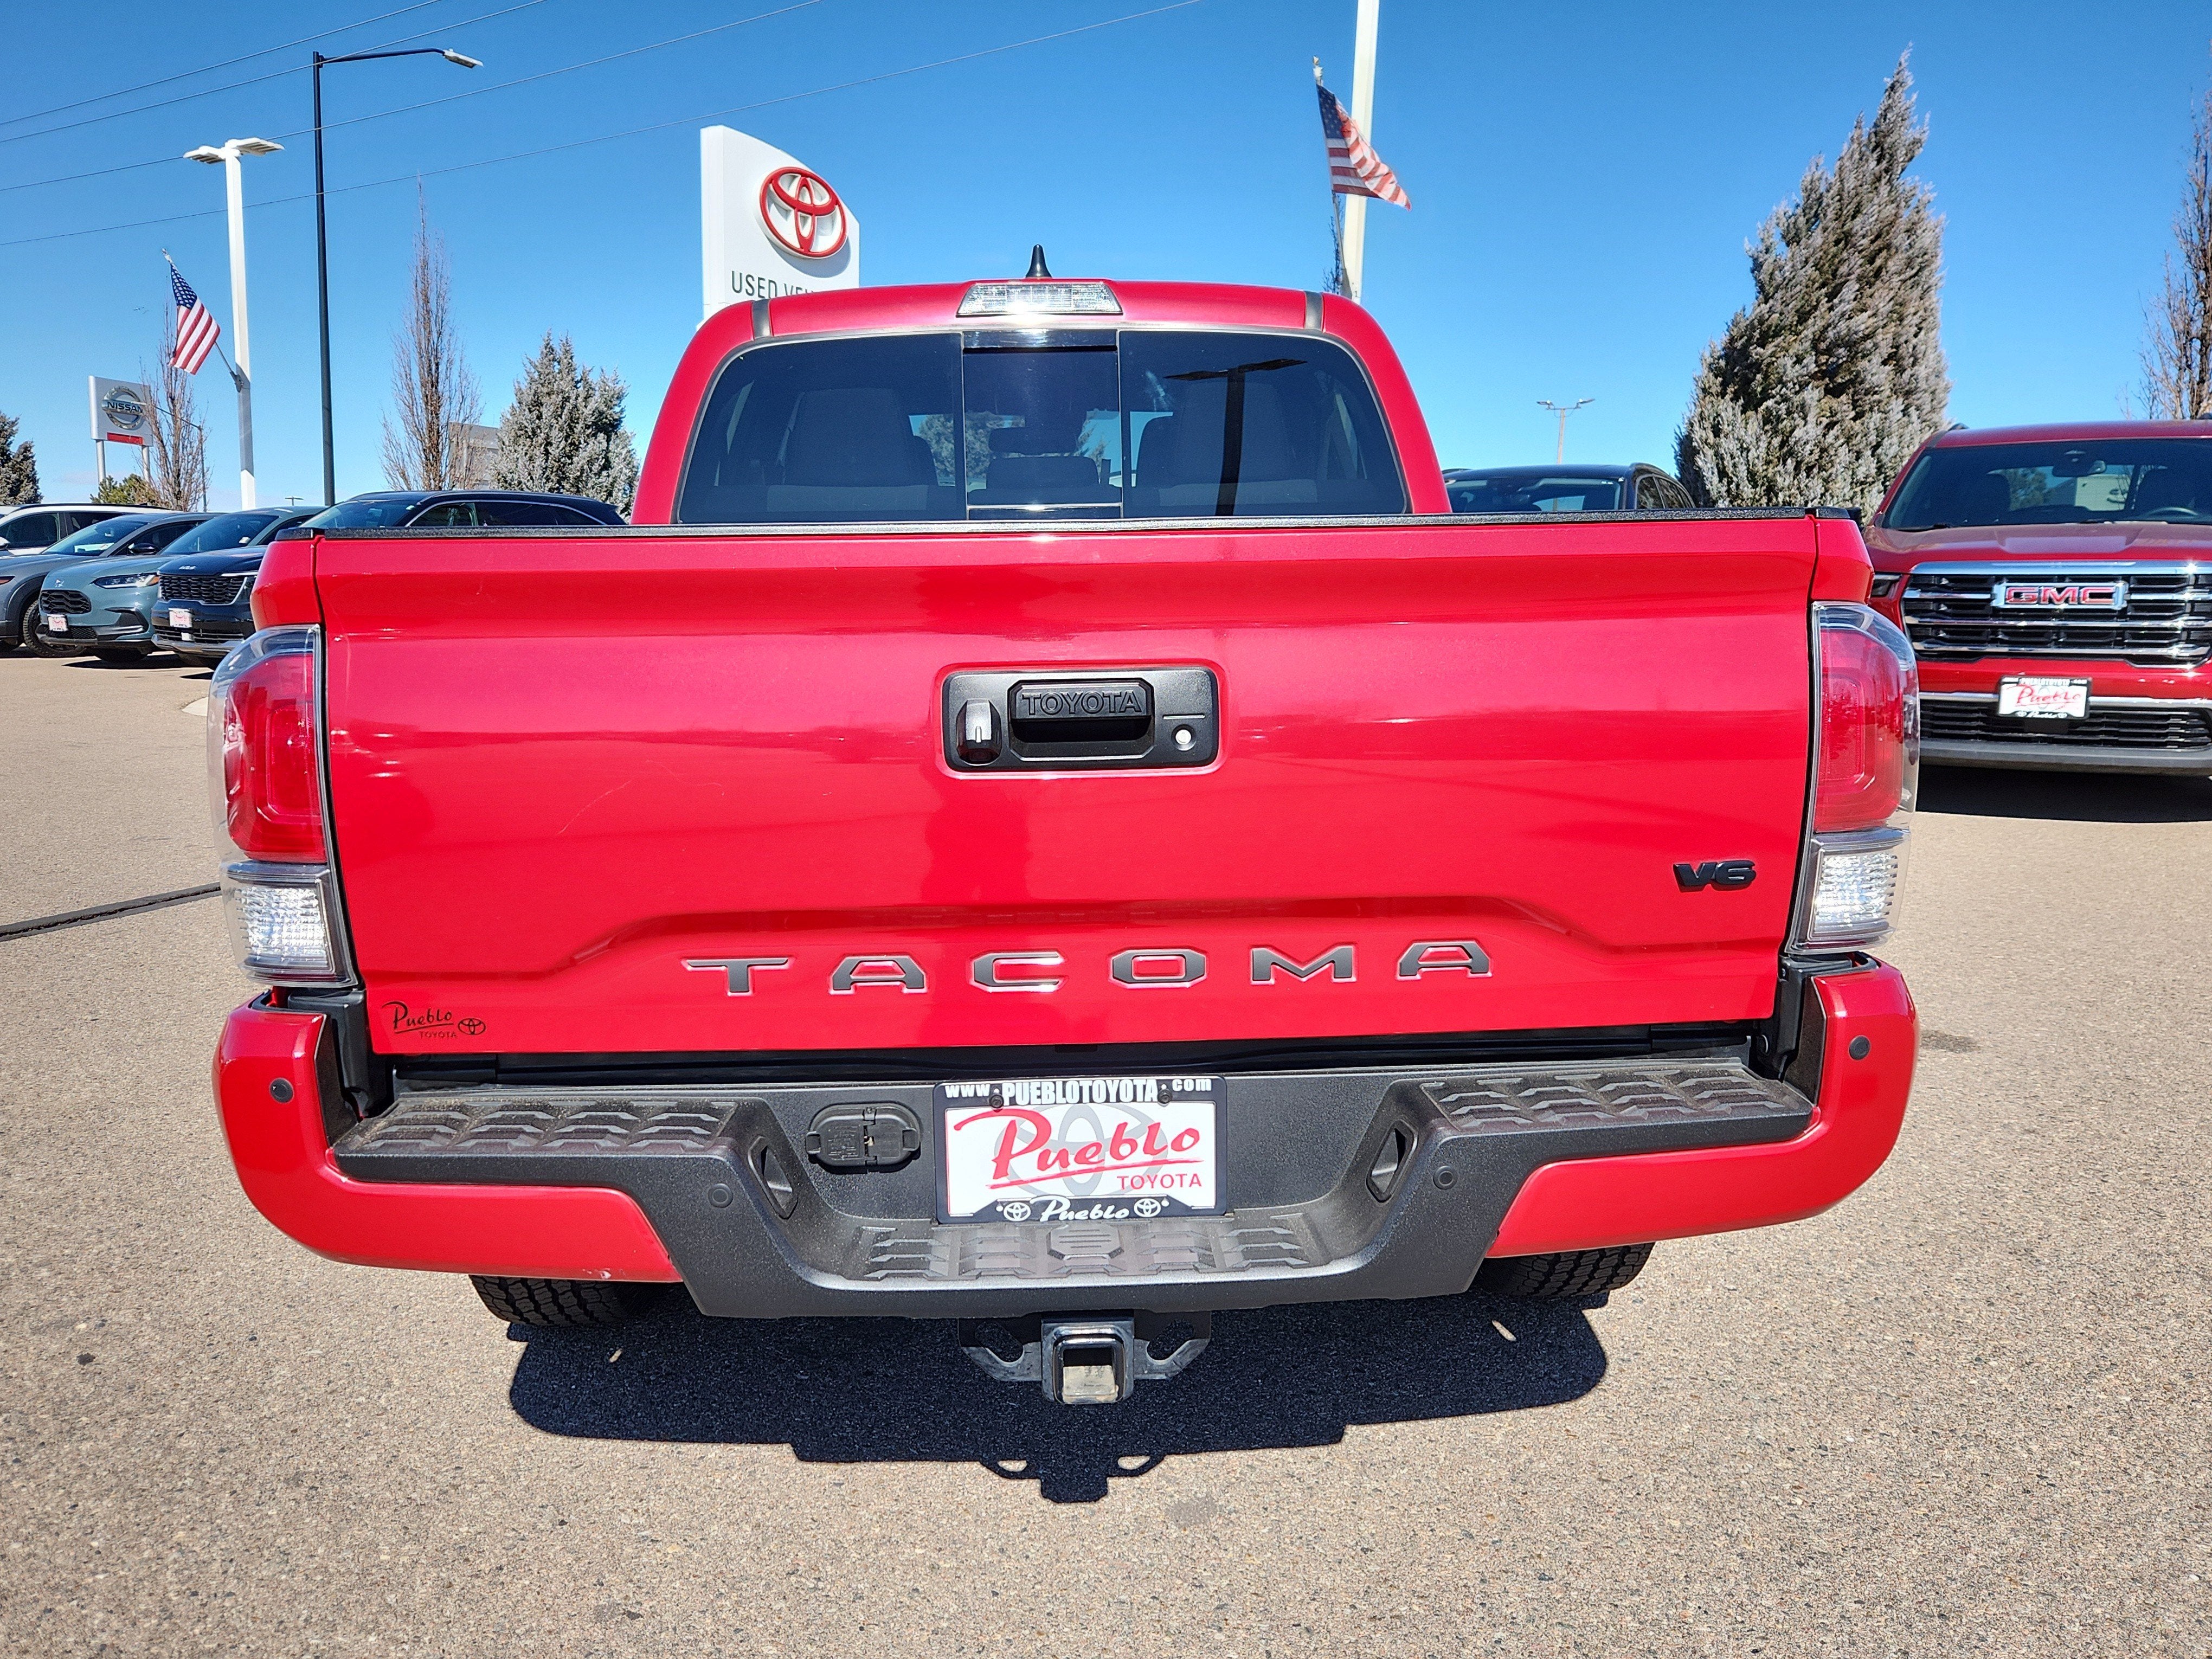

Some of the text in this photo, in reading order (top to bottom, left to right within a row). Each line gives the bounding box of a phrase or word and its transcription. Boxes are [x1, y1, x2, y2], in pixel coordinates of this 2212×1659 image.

[732, 271, 777, 299] USED
[107, 402, 143, 413] NISSAN
[2006, 587, 2115, 605] GMC
[1022, 690, 1142, 716] TOYOTA
[1673, 860, 1757, 889] V6
[681, 940, 1492, 996] TACOMA
[382, 1001, 452, 1029] Pueblo
[954, 1108, 1200, 1180] Pueblo
[1117, 1174, 1202, 1190] TOYOTA
[1031, 1194, 1129, 1222] Pueblo
